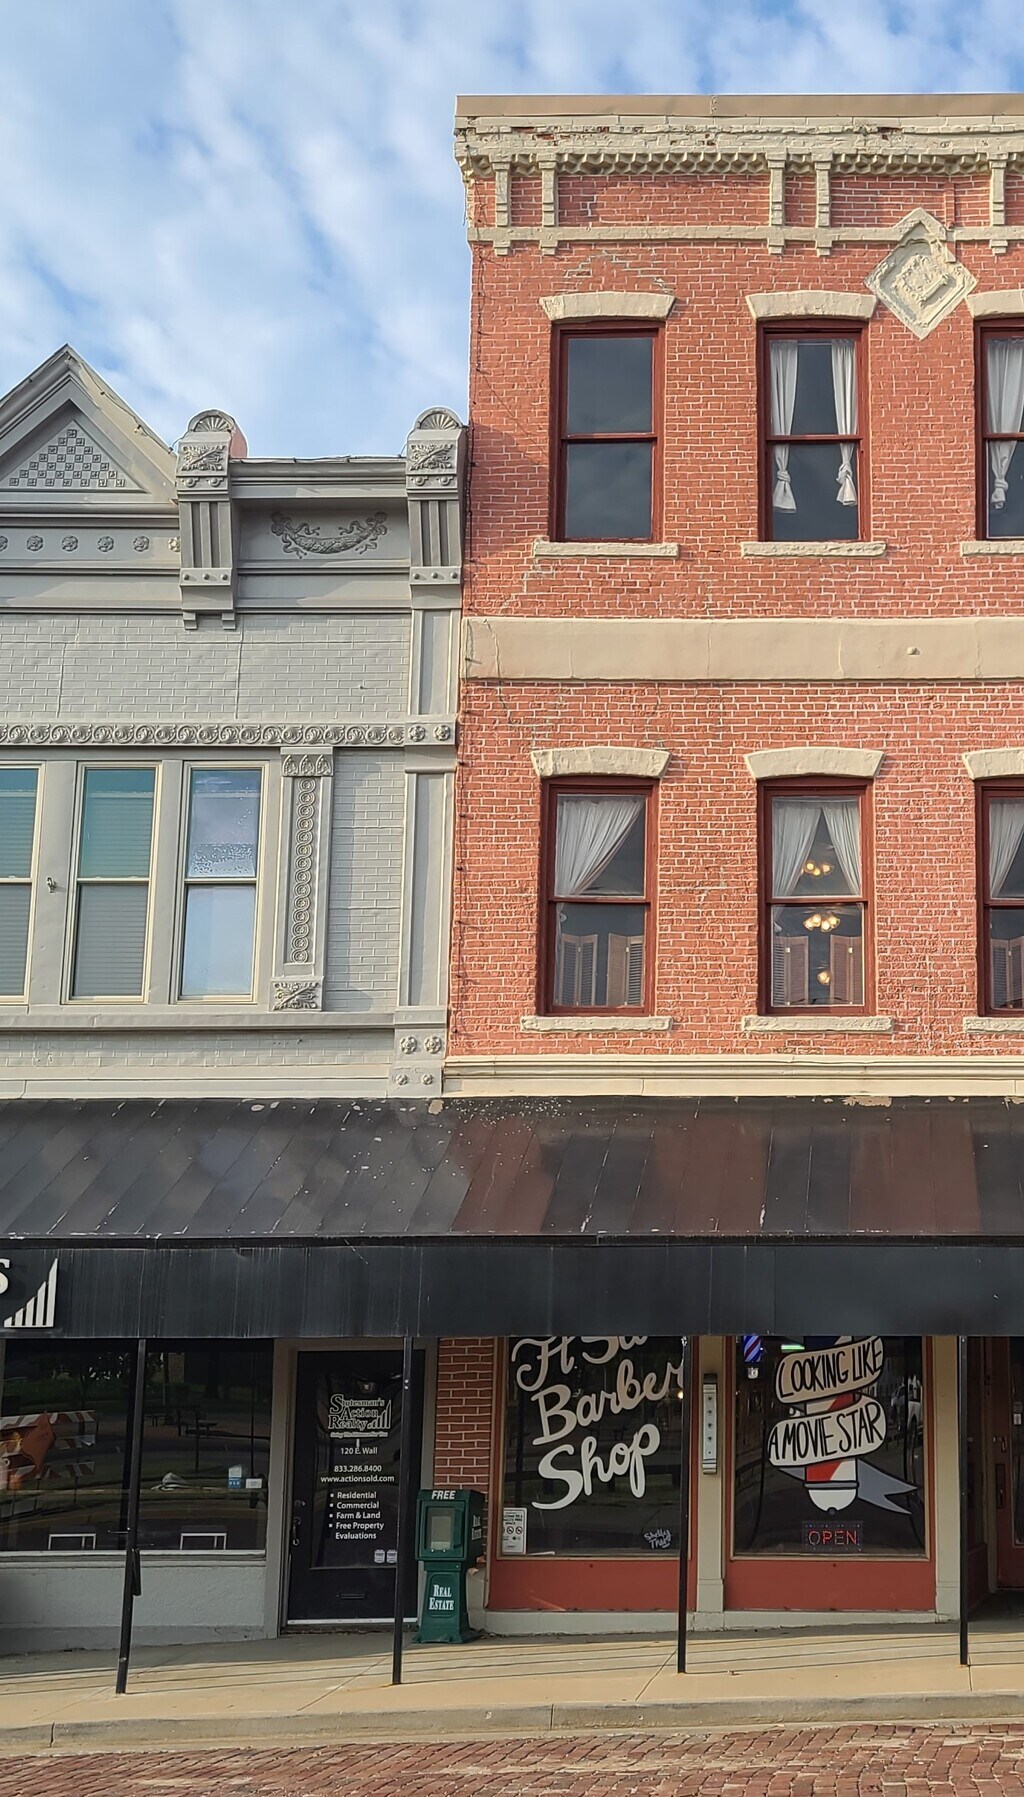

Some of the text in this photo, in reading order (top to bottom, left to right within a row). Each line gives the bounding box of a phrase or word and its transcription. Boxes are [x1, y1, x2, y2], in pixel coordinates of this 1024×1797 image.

[778, 1337, 883, 1398] LOOKING LIKE
[530, 1358, 684, 1446] Barber
[340, 1406, 379, 1420] Action
[327, 1414, 368, 1431] Realty
[769, 1401, 884, 1461] A MOVIE STAR
[341, 1447, 354, 1455] 120
[362, 1447, 378, 1455] Wall
[334, 1465, 382, 1473] 833.286.8400
[531, 1423, 661, 1510] Shop
[320, 1474, 395, 1483] www.actionsold.com
[337, 1491, 377, 1499] Residential
[431, 1490, 456, 1500] FREE
[336, 1501, 380, 1509] Commercial
[362, 1511, 381, 1519] Land
[335, 1522, 385, 1530] Free Property
[335, 1532, 377, 1540] Evaluations
[808, 1530, 858, 1545] OPEN
[428, 1597, 455, 1611] ESTATE
